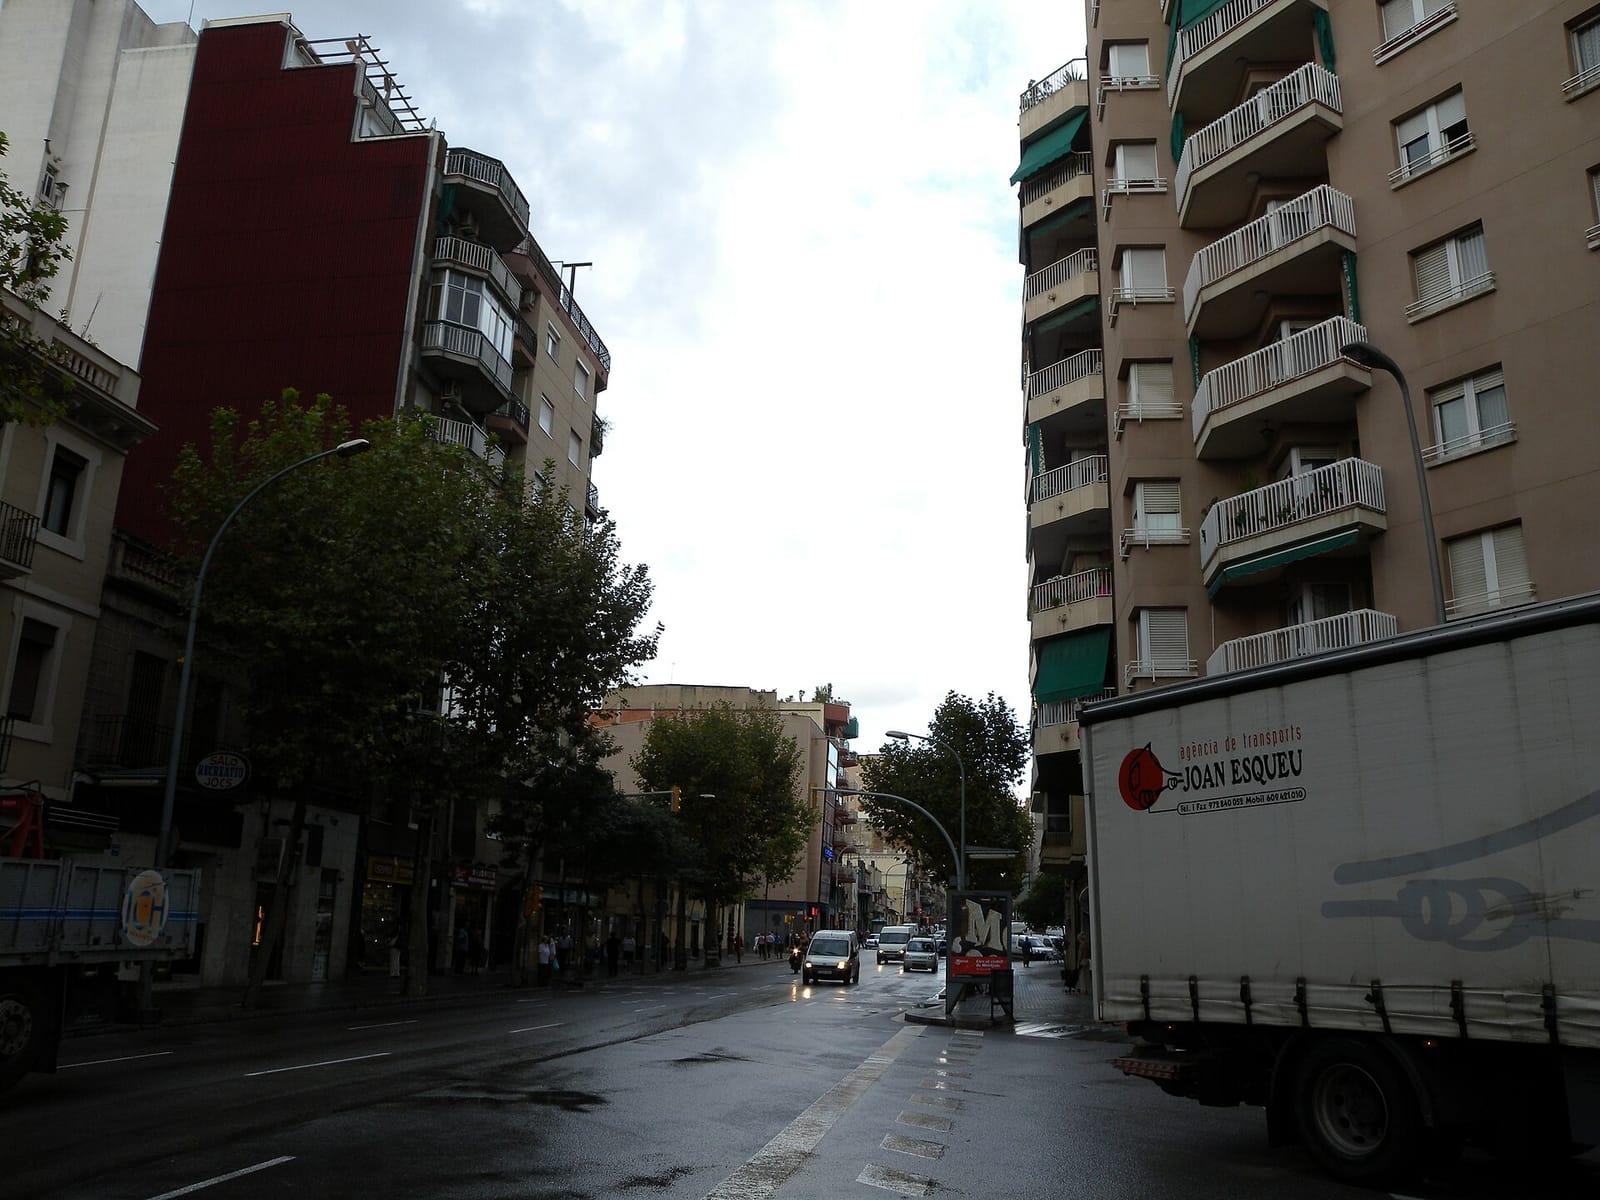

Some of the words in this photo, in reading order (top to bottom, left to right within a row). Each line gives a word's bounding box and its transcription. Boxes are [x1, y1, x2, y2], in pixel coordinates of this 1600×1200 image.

[1180, 740, 1219, 762] agència
[1224, 736, 1237, 752] de
[1243, 724, 1302, 750] transports
[204, 777, 233, 788] JOCS
[1183, 761, 1225, 792] JOAN
[1231, 749, 1302, 785] ESQUEU
[1196, 803, 1206, 811] Fax
